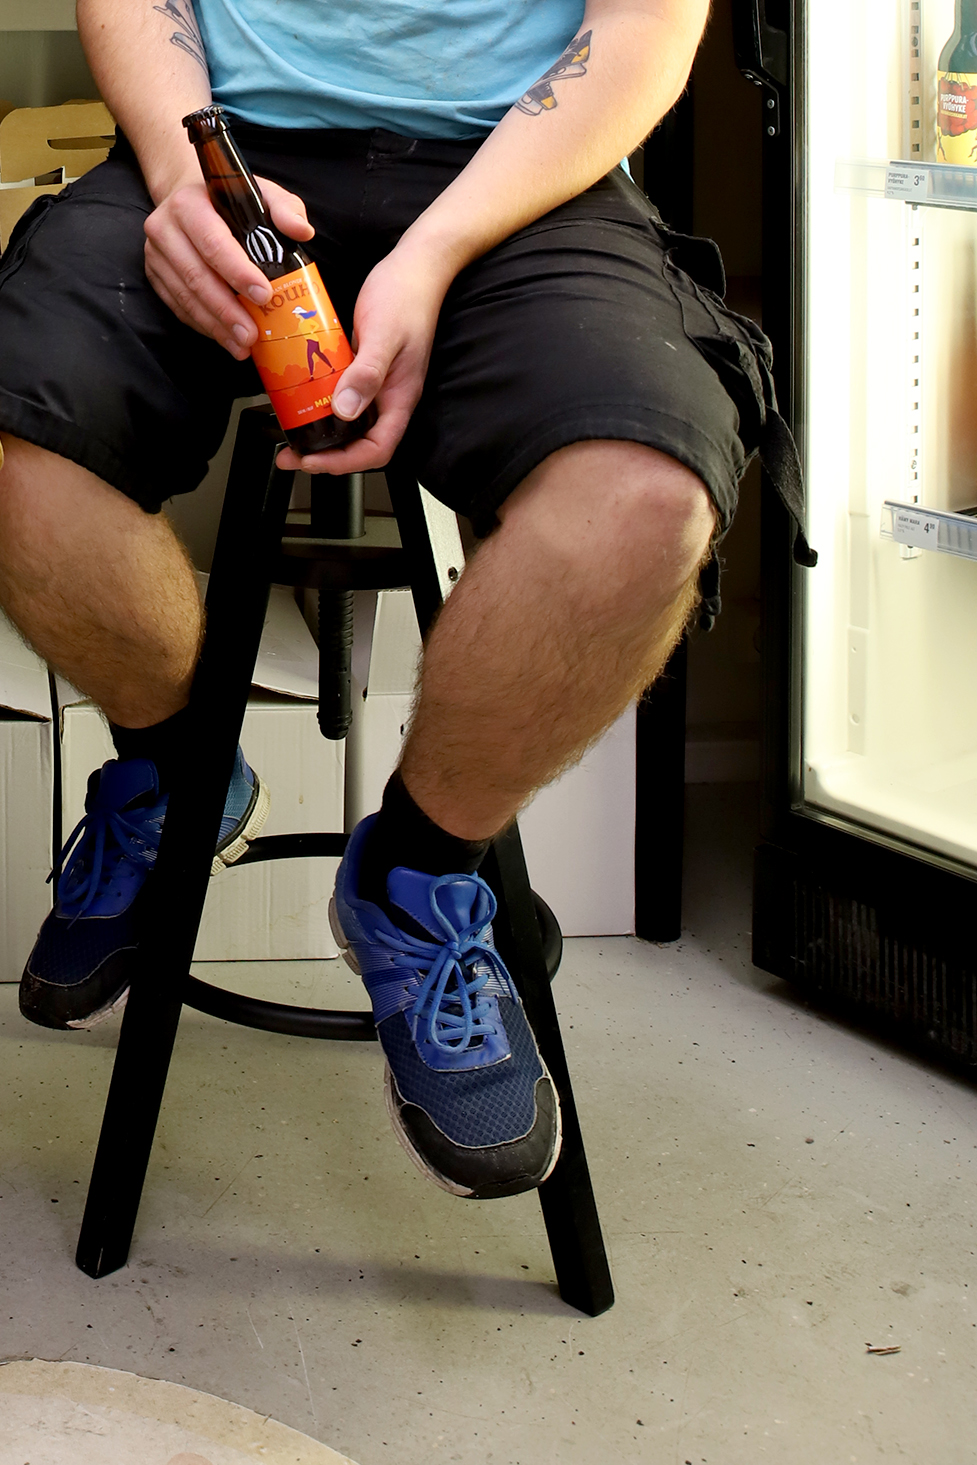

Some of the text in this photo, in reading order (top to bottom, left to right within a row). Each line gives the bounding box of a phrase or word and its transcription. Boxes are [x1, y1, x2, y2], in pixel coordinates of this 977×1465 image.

[940, 93, 969, 104] PURPPURA-
[943, 102, 966, 113] VYÖHYKE
[258, 280, 321, 317] KOUHO
